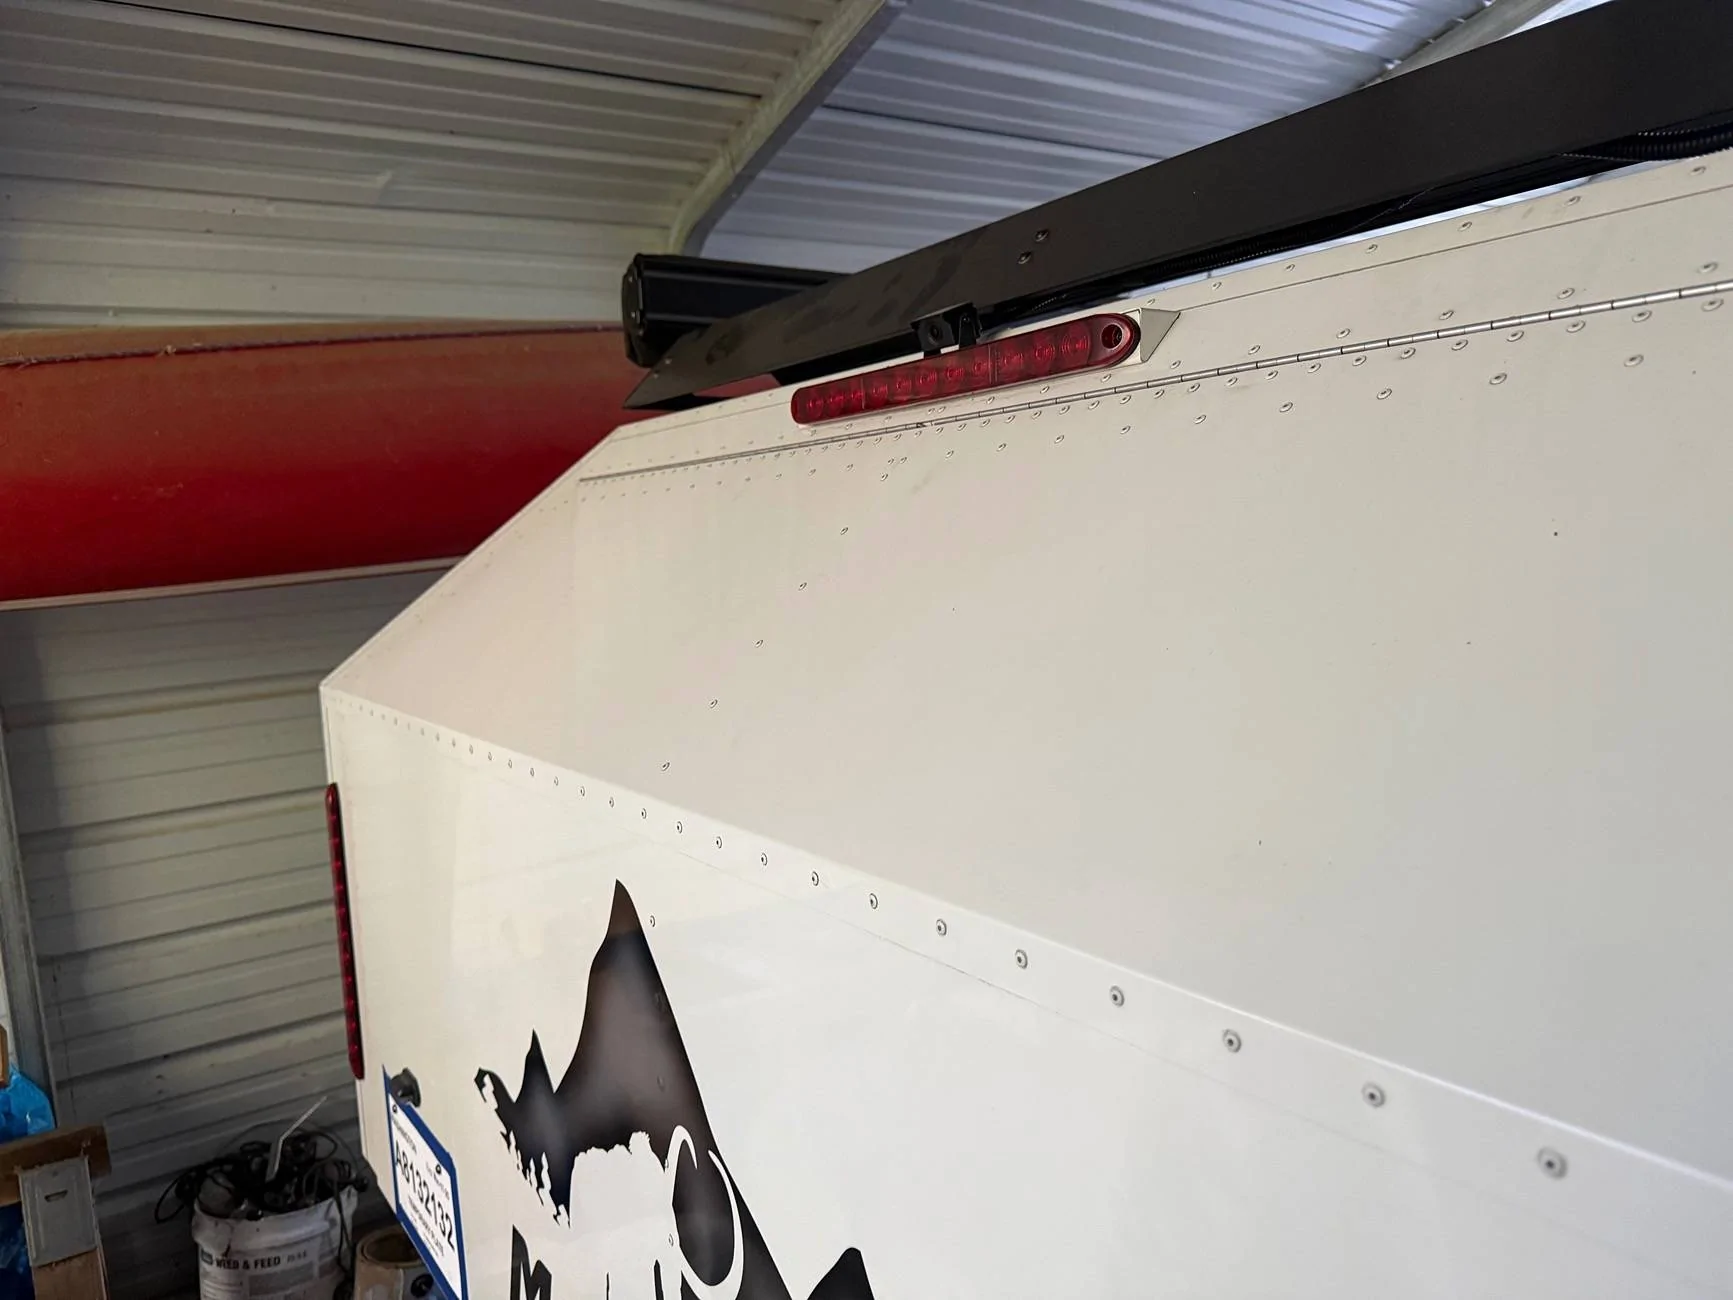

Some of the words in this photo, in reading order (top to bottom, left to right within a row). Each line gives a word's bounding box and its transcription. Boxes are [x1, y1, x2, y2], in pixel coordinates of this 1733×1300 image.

[395, 1139, 455, 1252] A8132132
[243, 1259, 250, 1270] &
[254, 1256, 280, 1269] FEED
